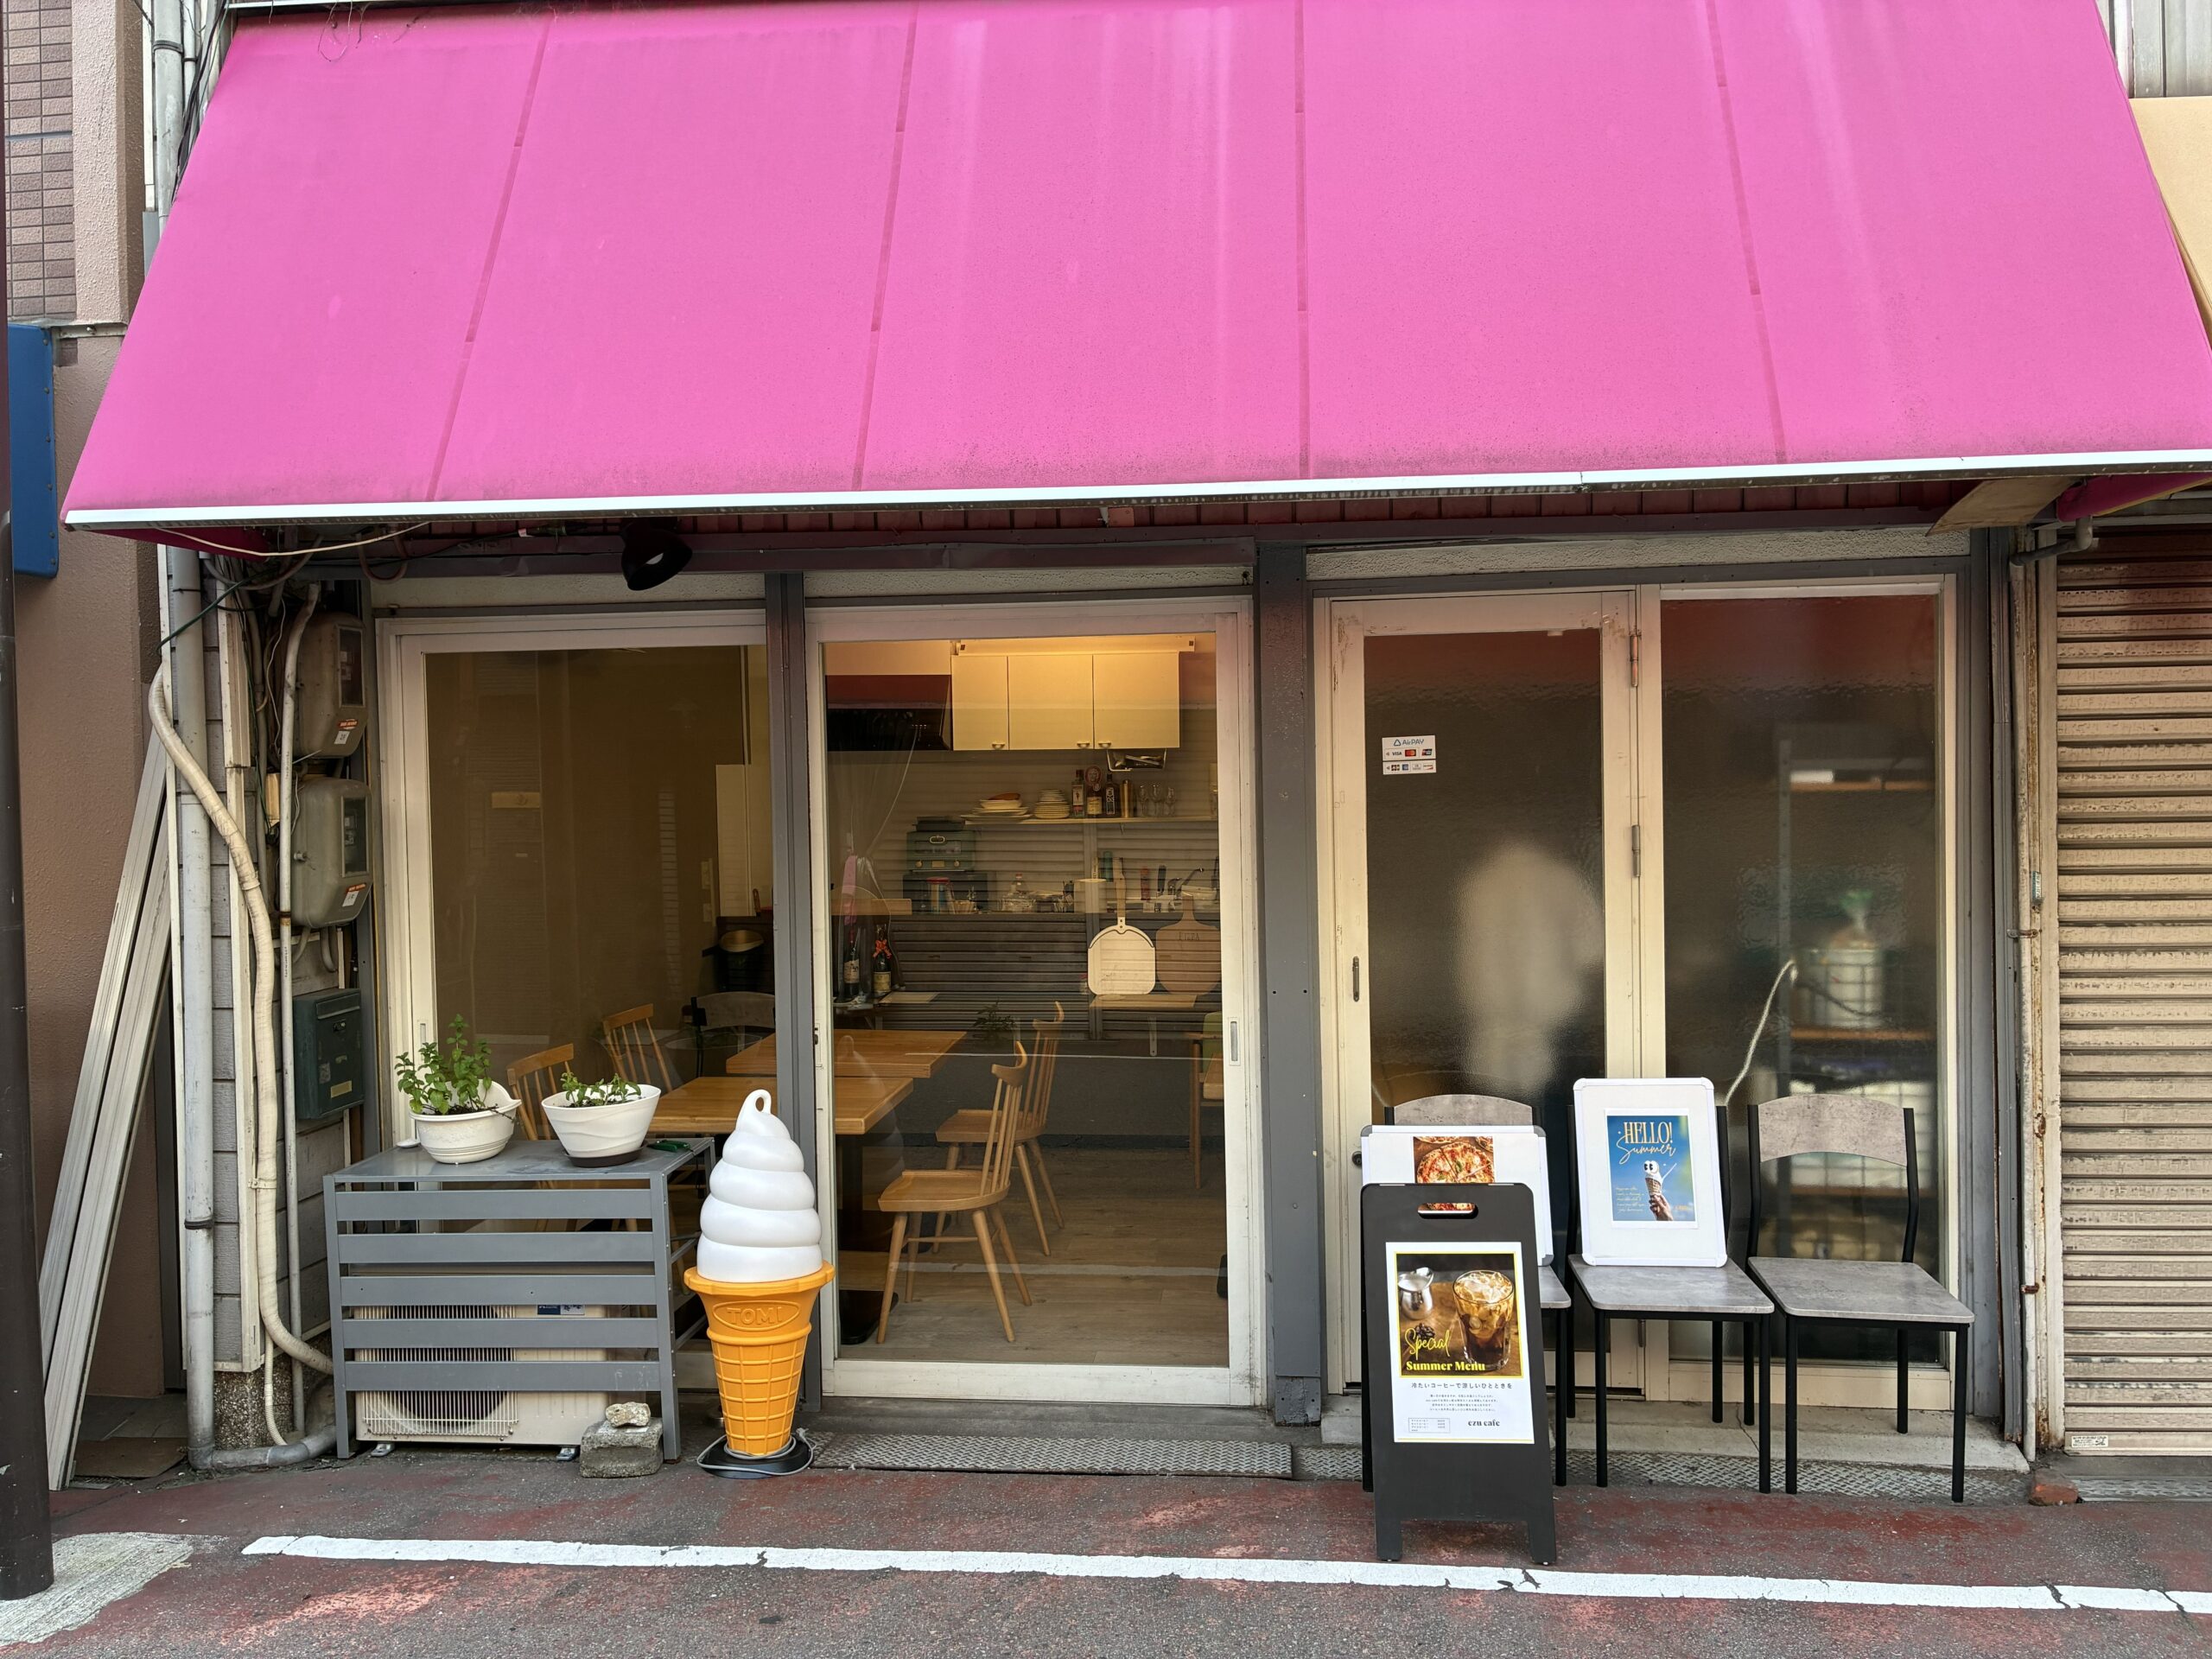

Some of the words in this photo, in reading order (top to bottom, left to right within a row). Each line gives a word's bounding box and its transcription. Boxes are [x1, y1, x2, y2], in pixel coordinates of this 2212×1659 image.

[1624, 1122, 1673, 1144] HELLO!
[1616, 1133, 1676, 1165] Summer
[727, 1306, 783, 1325] TOMI
[1404, 1327, 1451, 1360] Special
[1406, 1361, 1453, 1372] Summer
[1454, 1361, 1486, 1371] Menu
